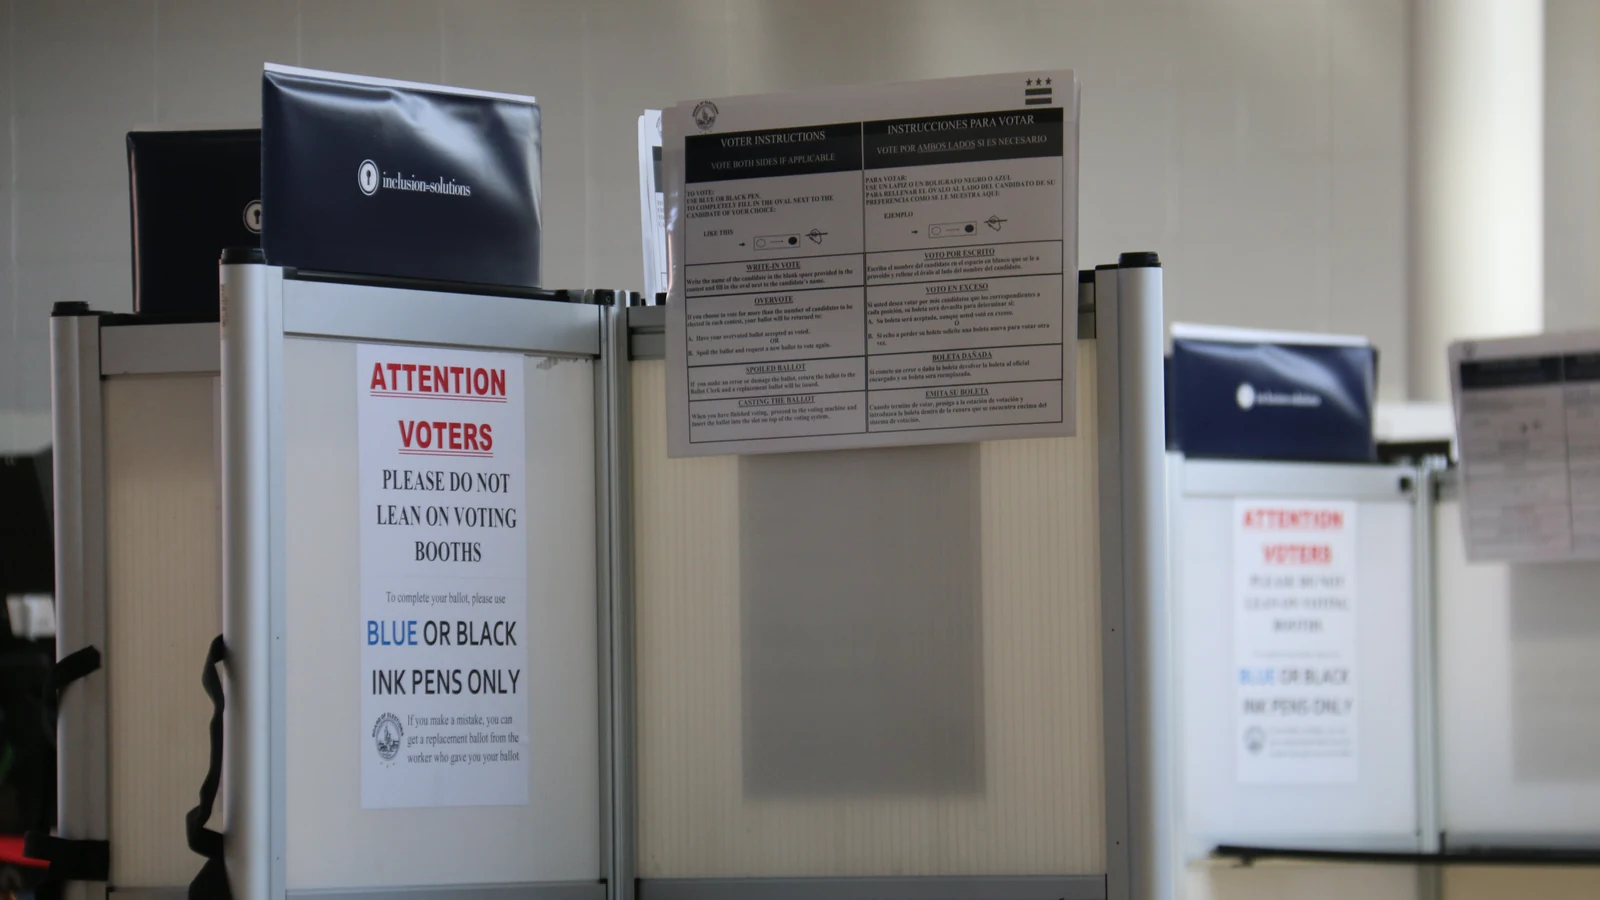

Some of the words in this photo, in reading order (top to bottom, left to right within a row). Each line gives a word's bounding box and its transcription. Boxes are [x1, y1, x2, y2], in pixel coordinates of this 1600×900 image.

[887, 118, 967, 135] INSTRUCCIONES
[969, 116, 996, 129] PARA
[998, 113, 1034, 127] VOTAR
[720, 135, 752, 148] VOTER
[754, 129, 825, 146] INSTRUCTIONS
[877, 145, 898, 155] VOTE
[900, 144, 915, 153] POR
[917, 141, 946, 152] AMBOS
[948, 139, 975, 150] LADOS
[977, 138, 985, 148] SI
[986, 138, 996, 147] ES
[998, 134, 1047, 146] NECESARIO
[711, 160, 731, 170] VOTE
[732, 158, 754, 168] BOTH
[755, 156, 777, 167] SIDES
[779, 156, 786, 165] IF
[788, 152, 835, 164] APPLICABLE
[883, 188, 917, 196] RELLENAR
[995, 180, 1034, 188] CANDIDATO
[696, 202, 736, 210] COMPLETELY
[865, 197, 909, 205] PREFERENCIA
[686, 210, 720, 218] CANDIDATE
[924, 250, 944, 259] VOTO
[946, 249, 961, 257] POR
[962, 247, 994, 256] ESCRITO
[746, 262, 779, 271] WRITE-IN
[780, 260, 800, 269] VOTE
[925, 285, 946, 293] VOTO
[947, 284, 957, 292] EN
[959, 282, 987, 291] EXCESO
[754, 295, 793, 304] OVERVOTE
[932, 352, 960, 361] BOLETA
[961, 349, 992, 359] DAÑADA
[745, 365, 775, 373] SPOILED
[777, 363, 805, 371] BALLOT
[370, 363, 506, 396] ATTENTION
[925, 390, 947, 398] EMITA
[949, 389, 958, 397] SU
[960, 387, 988, 396] BOLETA
[738, 397, 769, 406] CASTING
[770, 396, 785, 404] THE
[786, 395, 814, 403] BALLOT
[399, 420, 493, 451] VOTERS
[383, 469, 444, 491] PLEASE
[449, 471, 472, 492] DO
[477, 473, 510, 493] NOT
[376, 505, 421, 525] LEAN
[426, 506, 449, 526] ON
[454, 507, 517, 528] VOTING
[1243, 508, 1344, 530] ATTENTION
[415, 541, 481, 562] BOOTHS
[386, 592, 395, 602] To
[397, 592, 429, 605] complete
[431, 595, 446, 605] your
[449, 592, 470, 605] ballot,
[472, 593, 492, 606] please
[494, 596, 505, 604] use
[367, 621, 418, 646] BLUE
[424, 620, 450, 646] OR
[457, 621, 517, 646] BLACK
[372, 669, 406, 695] INK
[412, 669, 462, 694] PENS
[468, 669, 520, 694] ONLY
[407, 714, 414, 726] If
[415, 717, 428, 728] you
[430, 714, 448, 725] make
[450, 717, 455, 725] a
[457, 714, 484, 727] mistake,
[486, 716, 498, 728] you
[500, 716, 512, 724] can
[407, 735, 418, 747] get
[420, 736, 424, 745] a
[426, 734, 467, 747] replacement
[469, 732, 489, 743] ballot
[490, 732, 506, 743] from
[508, 732, 519, 743] the
[407, 752, 432, 763] worker
[434, 751, 449, 763] who
[451, 754, 466, 765] gave
[468, 753, 481, 764] you
[483, 753, 498, 765] your
[500, 750, 519, 762] ballot
